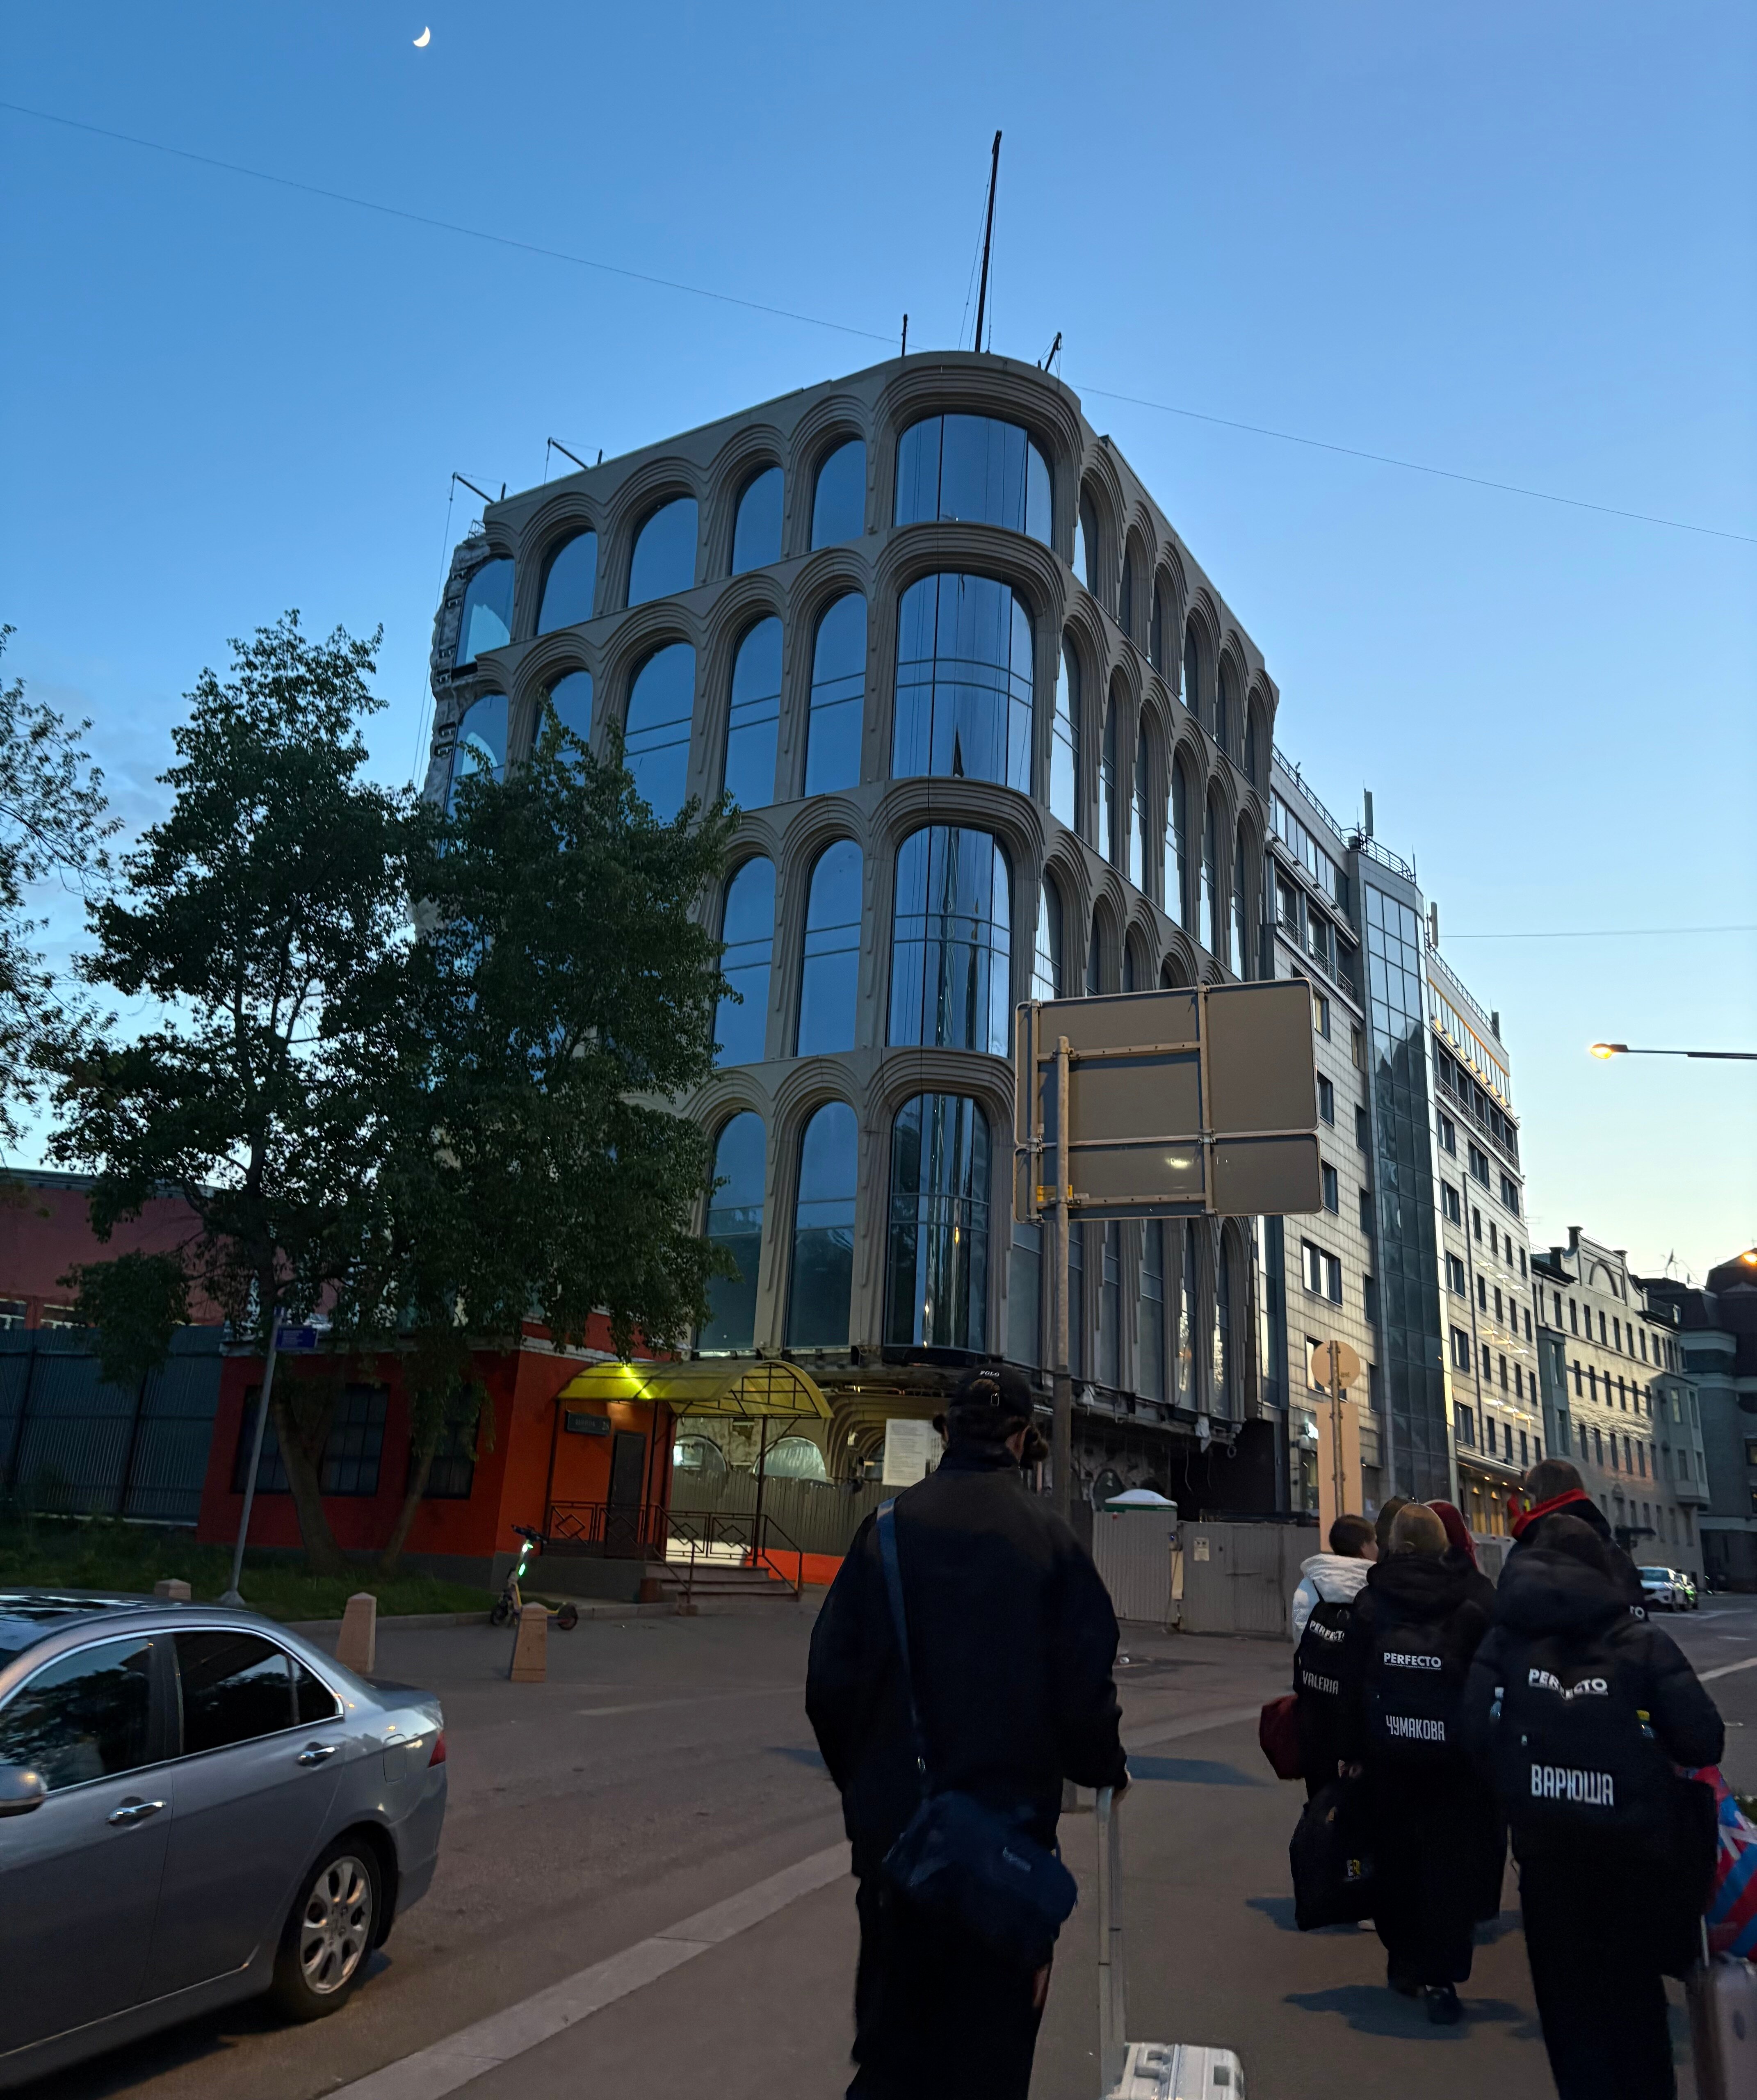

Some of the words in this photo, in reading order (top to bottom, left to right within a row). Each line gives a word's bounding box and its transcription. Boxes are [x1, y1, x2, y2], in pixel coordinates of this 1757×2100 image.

[1384, 1652, 1442, 1668] PERFECTO
[1303, 1670, 1339, 1695] VALERIA
[1385, 1715, 1446, 1741] ЧУМАКОВА
[1531, 1764, 1614, 1807] ВАРЮША
